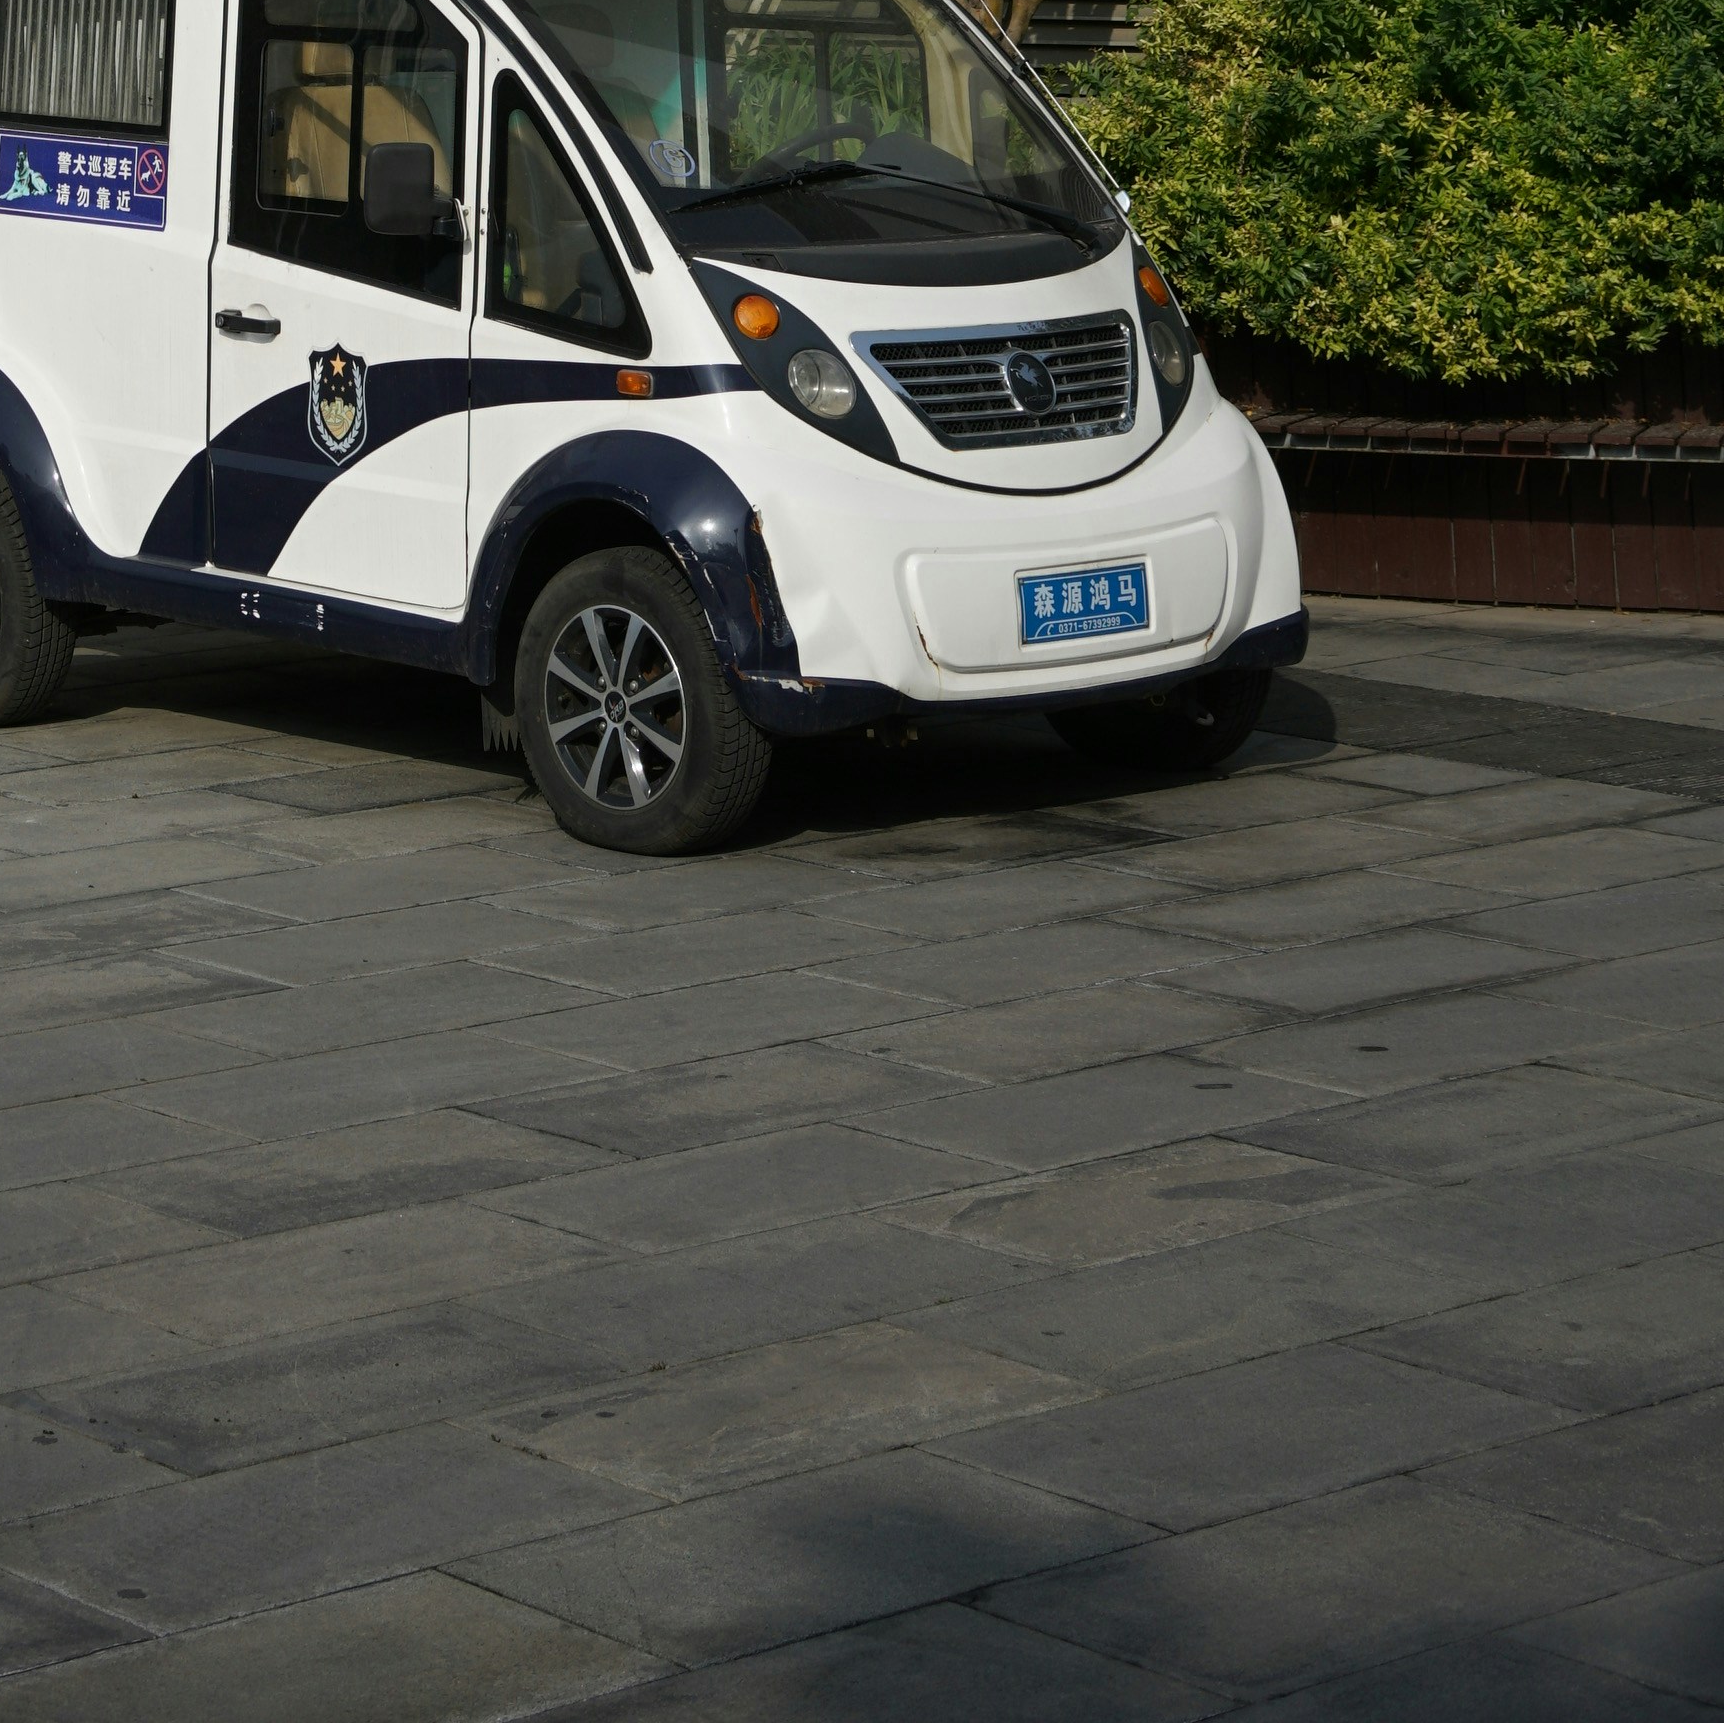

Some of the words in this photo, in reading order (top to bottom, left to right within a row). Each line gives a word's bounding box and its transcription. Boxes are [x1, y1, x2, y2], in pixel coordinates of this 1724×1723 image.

[57, 151, 133, 181] 警犬巡逻车
[56, 182, 132, 213] 请勿靠近
[1033, 574, 1137, 619] 森源鸿马
[1058, 616, 1121, 634] 0371-67392999
